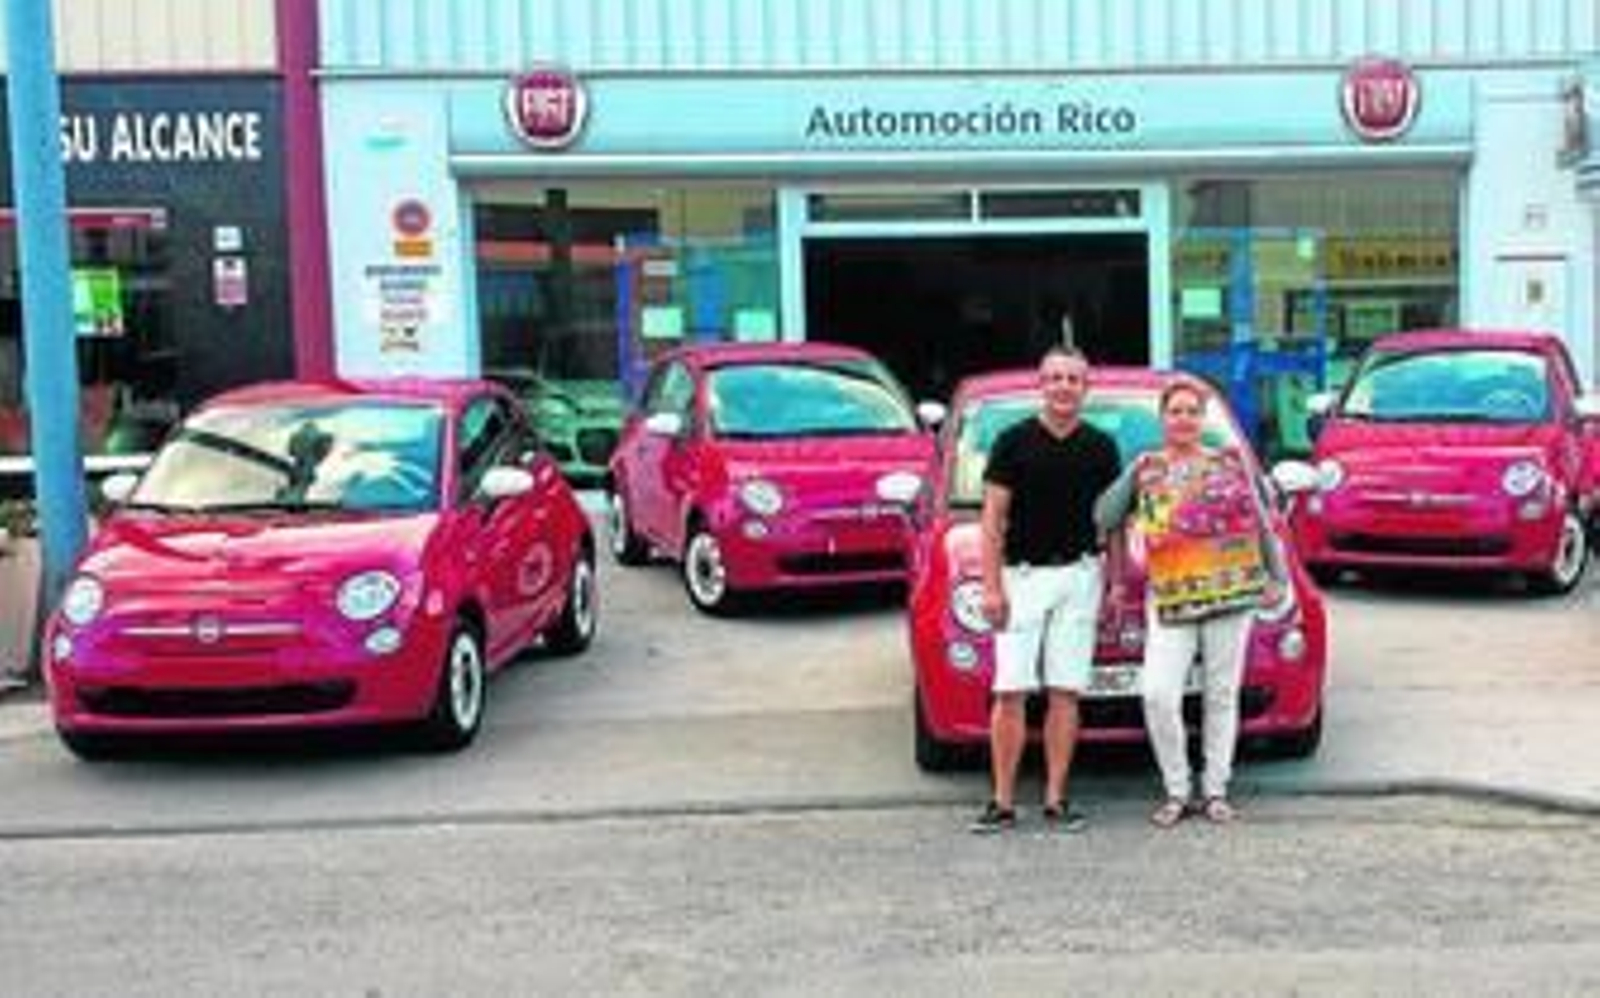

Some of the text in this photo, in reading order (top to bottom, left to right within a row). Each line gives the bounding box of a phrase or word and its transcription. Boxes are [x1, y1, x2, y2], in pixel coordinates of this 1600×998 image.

[110, 111, 262, 161] ALCANCE
[805, 100, 1136, 137] Automoción Rico
